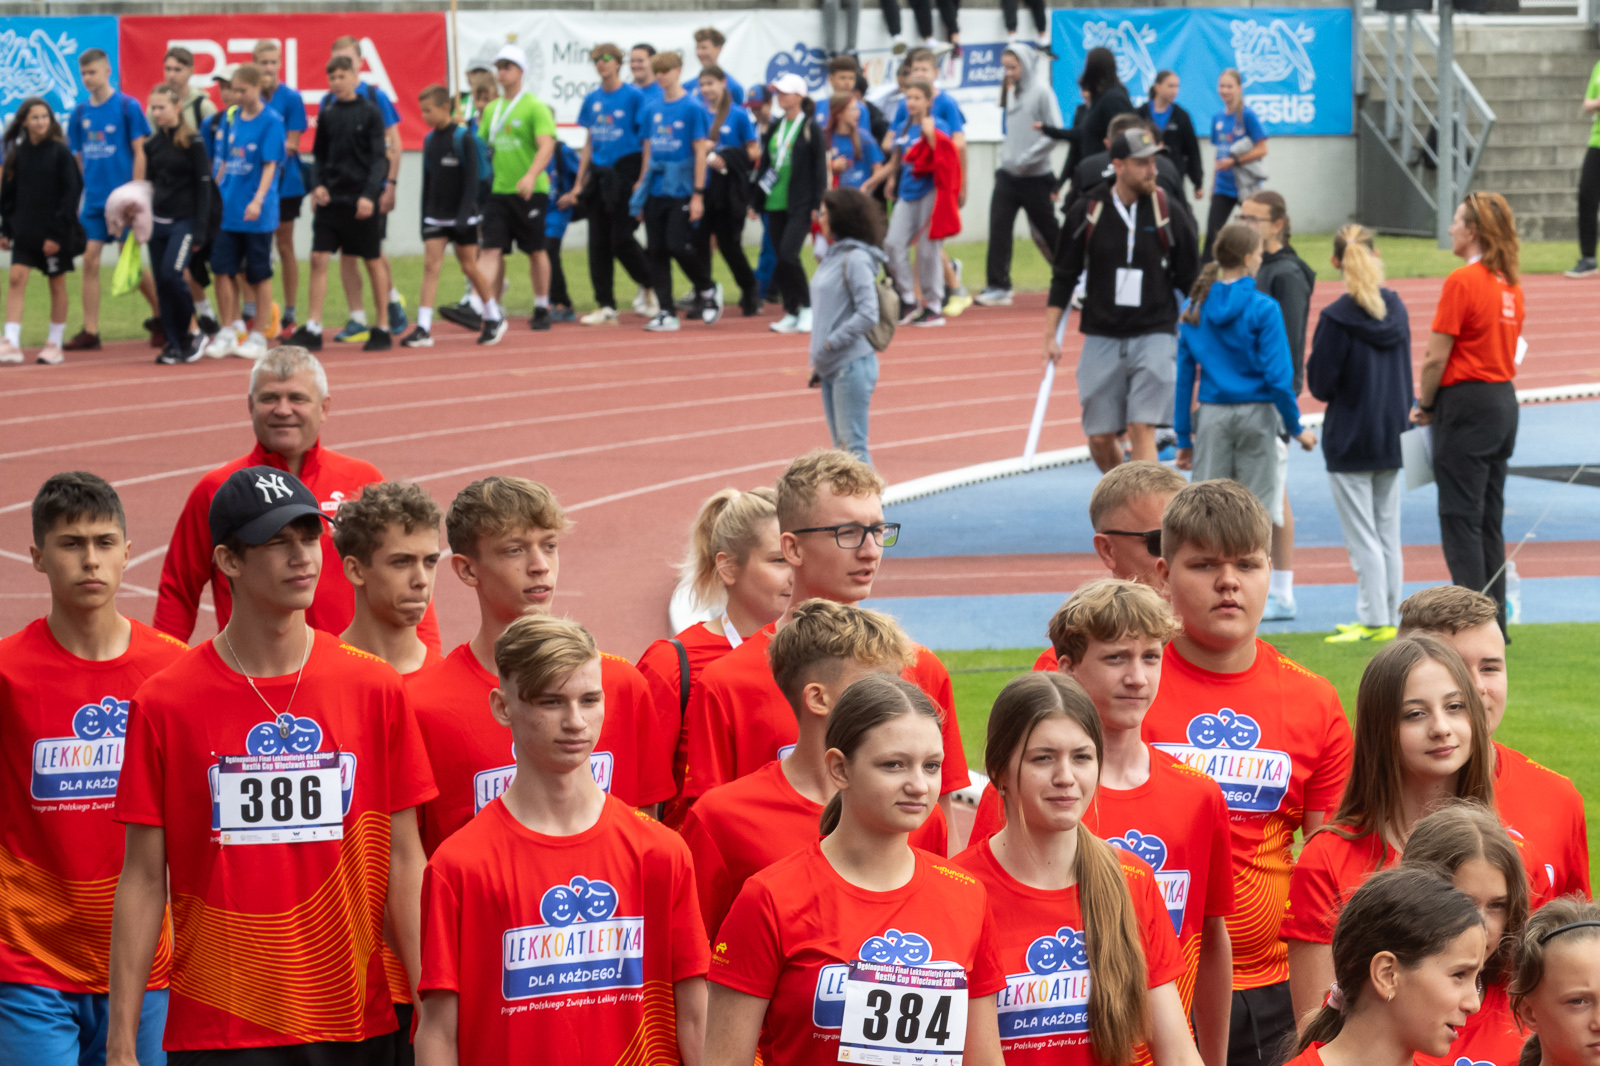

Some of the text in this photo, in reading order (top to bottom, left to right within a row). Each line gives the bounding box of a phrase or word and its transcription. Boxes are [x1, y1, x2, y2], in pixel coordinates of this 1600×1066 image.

[1245, 93, 1316, 123] estlé
[59, 780, 83, 791] DLA
[240, 775, 322, 823] 386
[510, 926, 642, 963] LEKKOATLETYKA
[528, 957, 625, 988] DLA KAŻDEGO!
[529, 999, 564, 1011] Polskiego
[566, 996, 595, 1008] Związku
[862, 989, 952, 1046] 384
[1014, 1011, 1089, 1030] DLA KAŻDEG
[1013, 1038, 1076, 1052] Polskiego Związku
